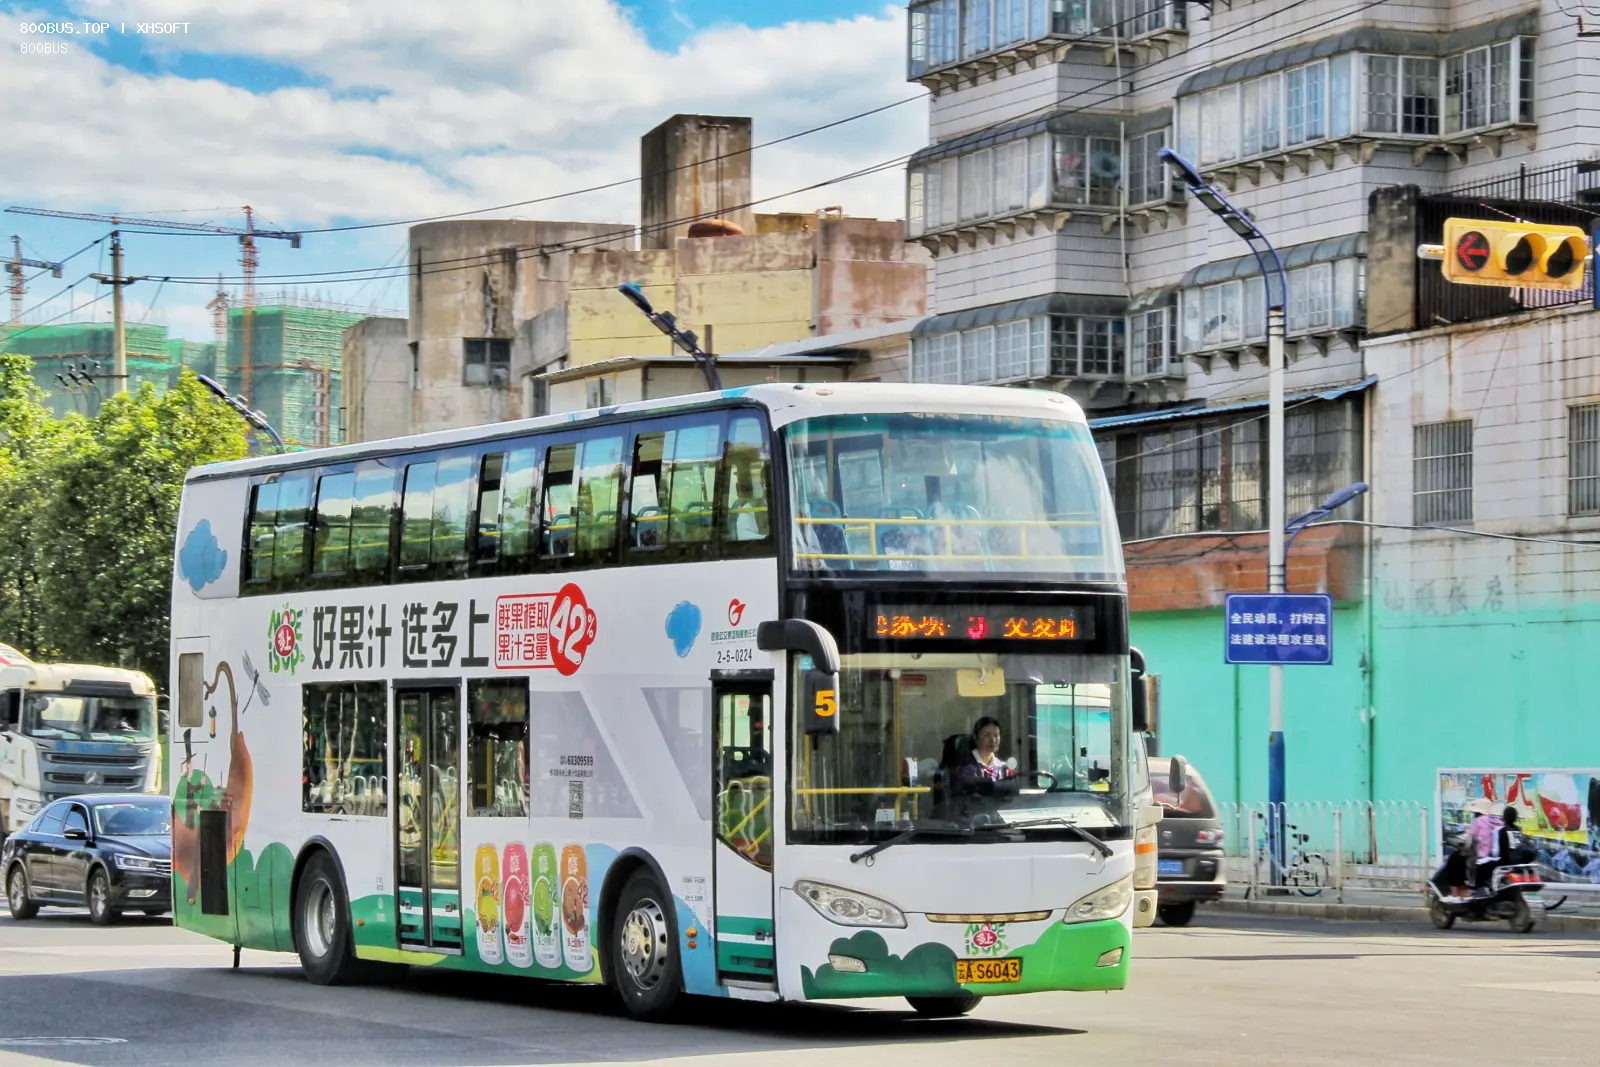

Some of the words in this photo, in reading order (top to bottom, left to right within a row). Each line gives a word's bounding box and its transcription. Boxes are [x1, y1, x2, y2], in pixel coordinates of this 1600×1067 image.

[498, 601, 549, 631] 鲜果榨取
[277, 628, 292, 653] 多上
[312, 604, 392, 670] 好果汁
[401, 598, 490, 669] 选多上
[550, 596, 595, 665] 42%
[1230, 633, 1327, 646] 法建设治理攻坚战
[498, 632, 548, 661] 果汁含量
[717, 648, 753, 664] 2-5-0224
[814, 689, 837, 717] 5
[976, 933, 994, 945] 多上
